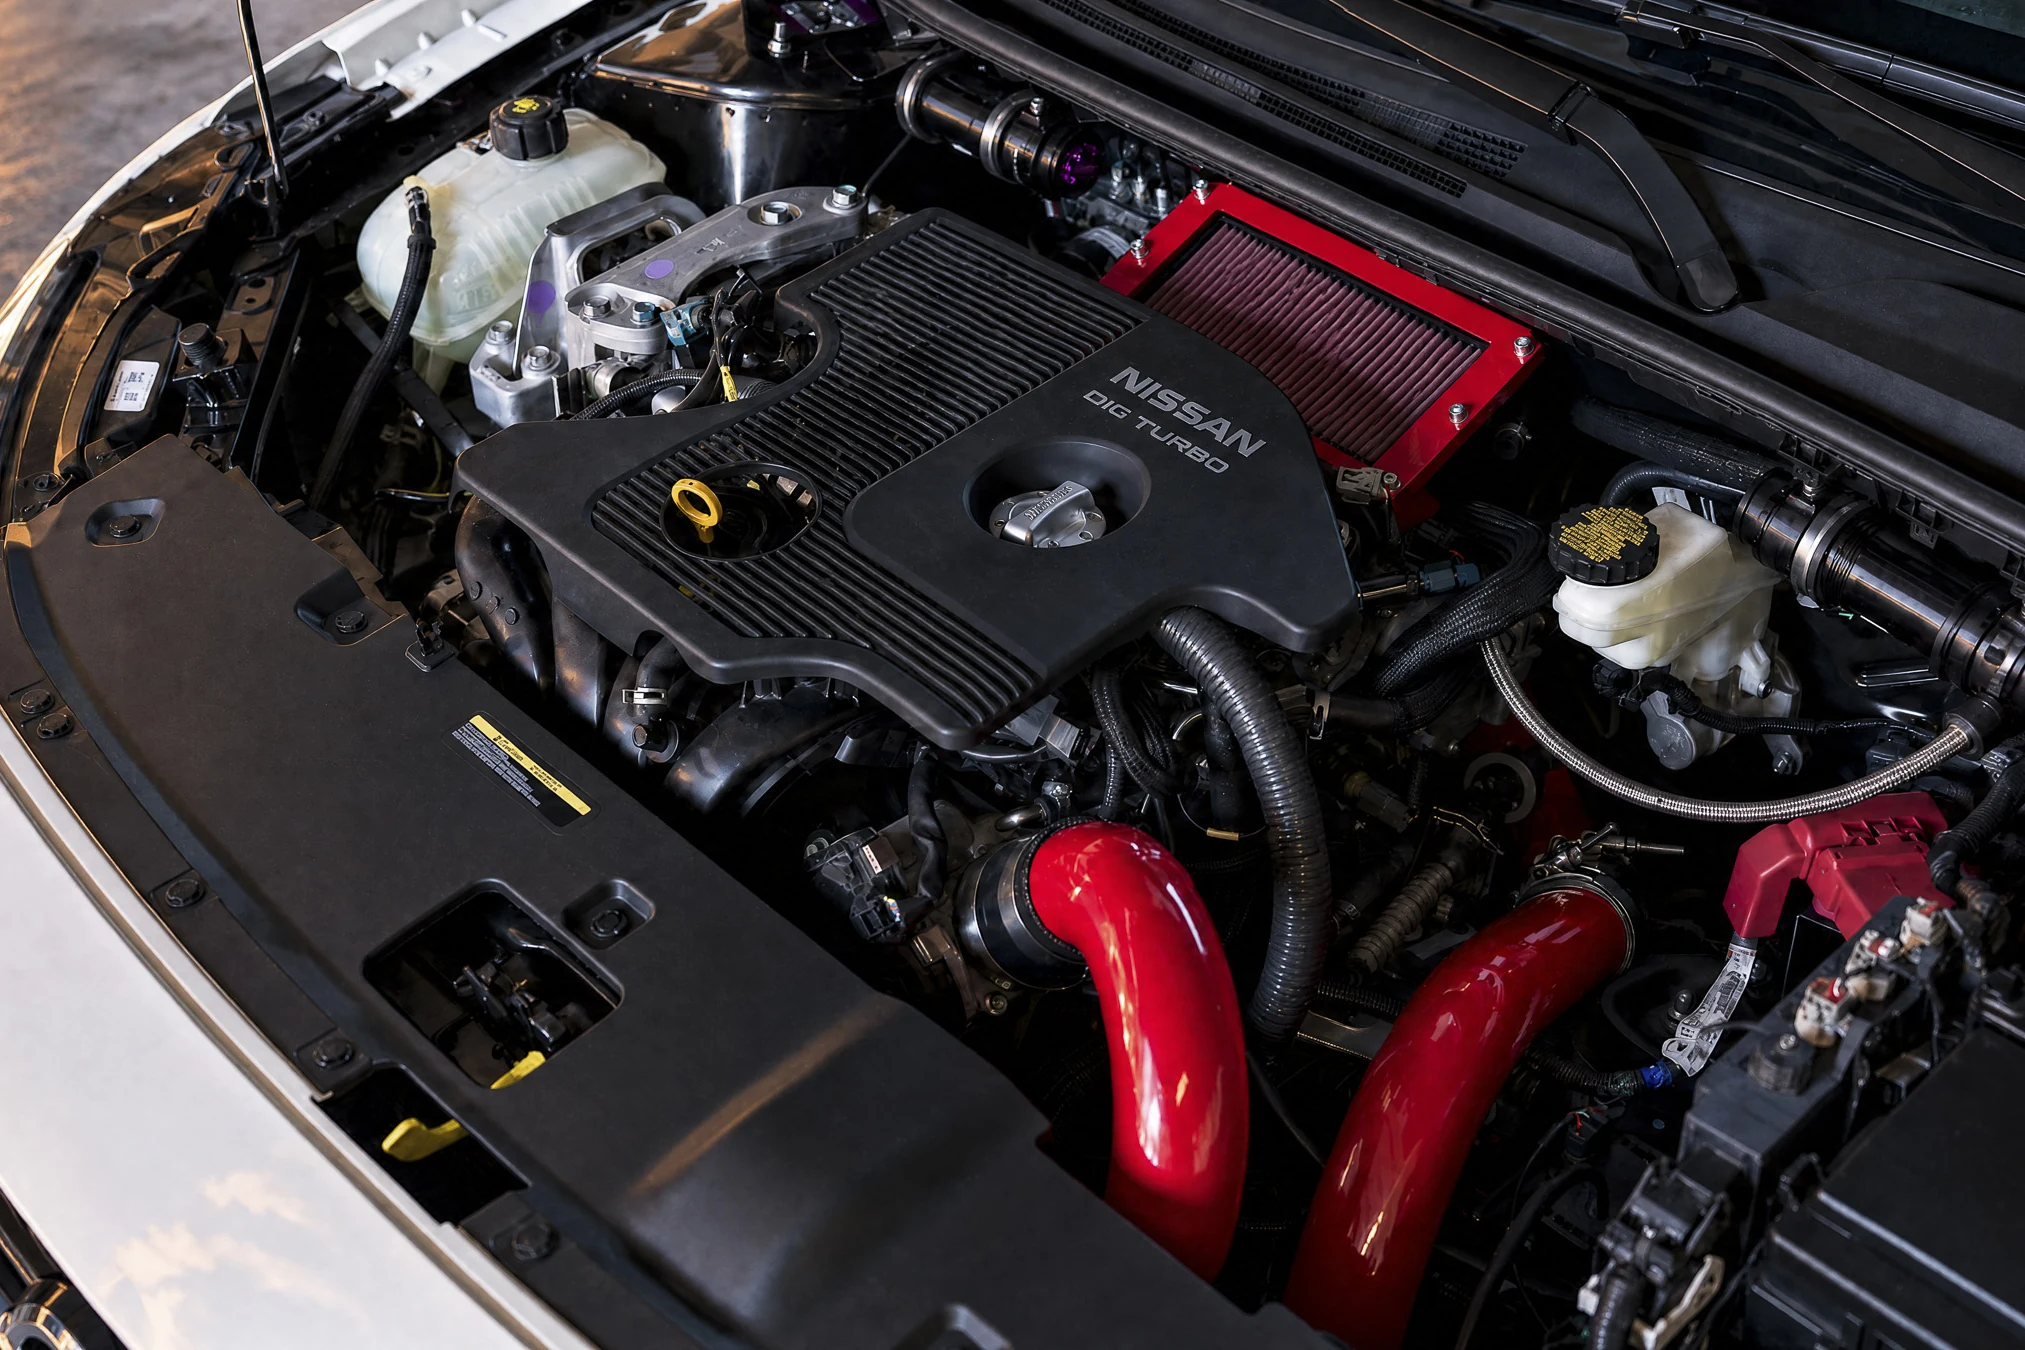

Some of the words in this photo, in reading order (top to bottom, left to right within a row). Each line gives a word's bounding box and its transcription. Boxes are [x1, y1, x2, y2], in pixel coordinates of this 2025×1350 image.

[1082, 389, 1132, 420] DIG
[1135, 415, 1230, 474] TURBO
[1109, 366, 1267, 458] NISSAN
